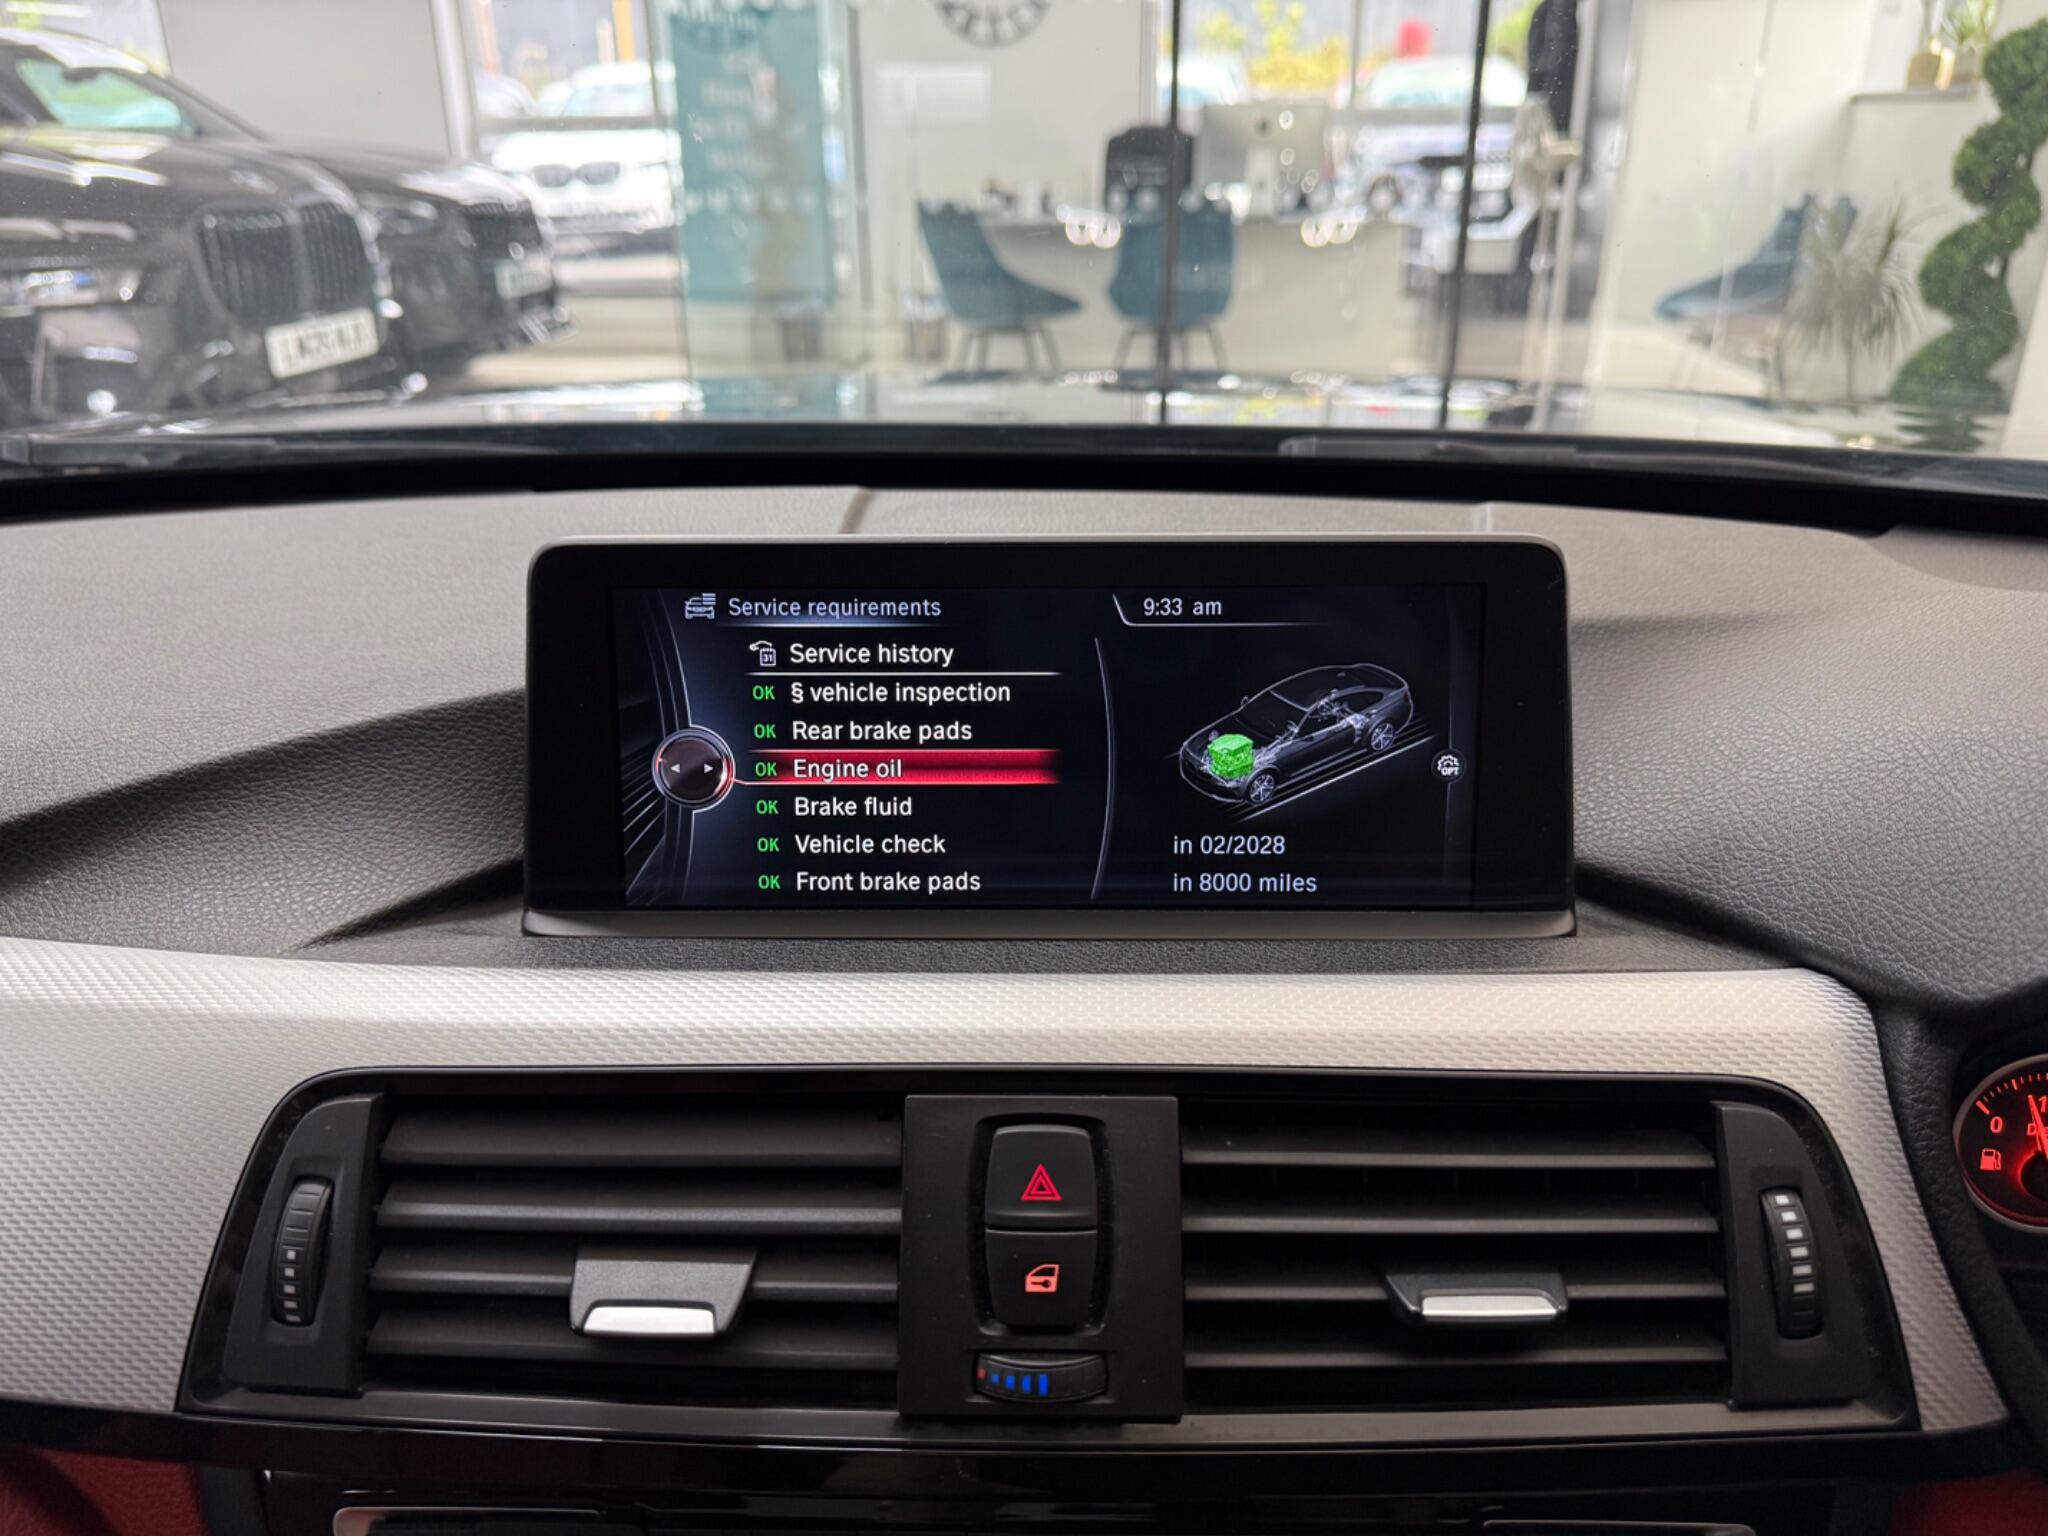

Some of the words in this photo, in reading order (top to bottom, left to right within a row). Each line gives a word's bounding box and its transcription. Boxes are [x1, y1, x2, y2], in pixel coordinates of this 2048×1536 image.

[728, 597, 802, 616] Service
[807, 597, 942, 619] requirements
[1143, 597, 1183, 616] 9:33
[1192, 601, 1222, 616] am
[790, 643, 871, 663] Service
[878, 643, 954, 668] history
[752, 685, 775, 700] OK
[791, 681, 804, 704] §
[810, 682, 888, 702] vehicle
[895, 682, 1011, 706] inspection
[754, 724, 777, 739] OK
[792, 720, 844, 740] Rear
[849, 720, 912, 740] brake
[918, 720, 973, 745] pads
[755, 762, 778, 777] OK
[794, 759, 869, 783] Engine
[876, 759, 902, 778] oil
[756, 800, 778, 815] OK
[795, 797, 857, 816] Brake
[864, 796, 912, 816] fluid
[757, 837, 780, 852] OK
[794, 834, 874, 854] Vehicle
[881, 834, 946, 854] check
[1174, 835, 1192, 854] in
[1200, 835, 1286, 855] 02/2028
[758, 875, 780, 890] OK
[796, 871, 854, 891] Front
[860, 871, 921, 891] brake
[928, 871, 981, 895] pads
[1174, 873, 1192, 892] in
[1199, 873, 1252, 892] 8000
[1259, 873, 1317, 892] miles
[1990, 1116, 2003, 1133] 0
